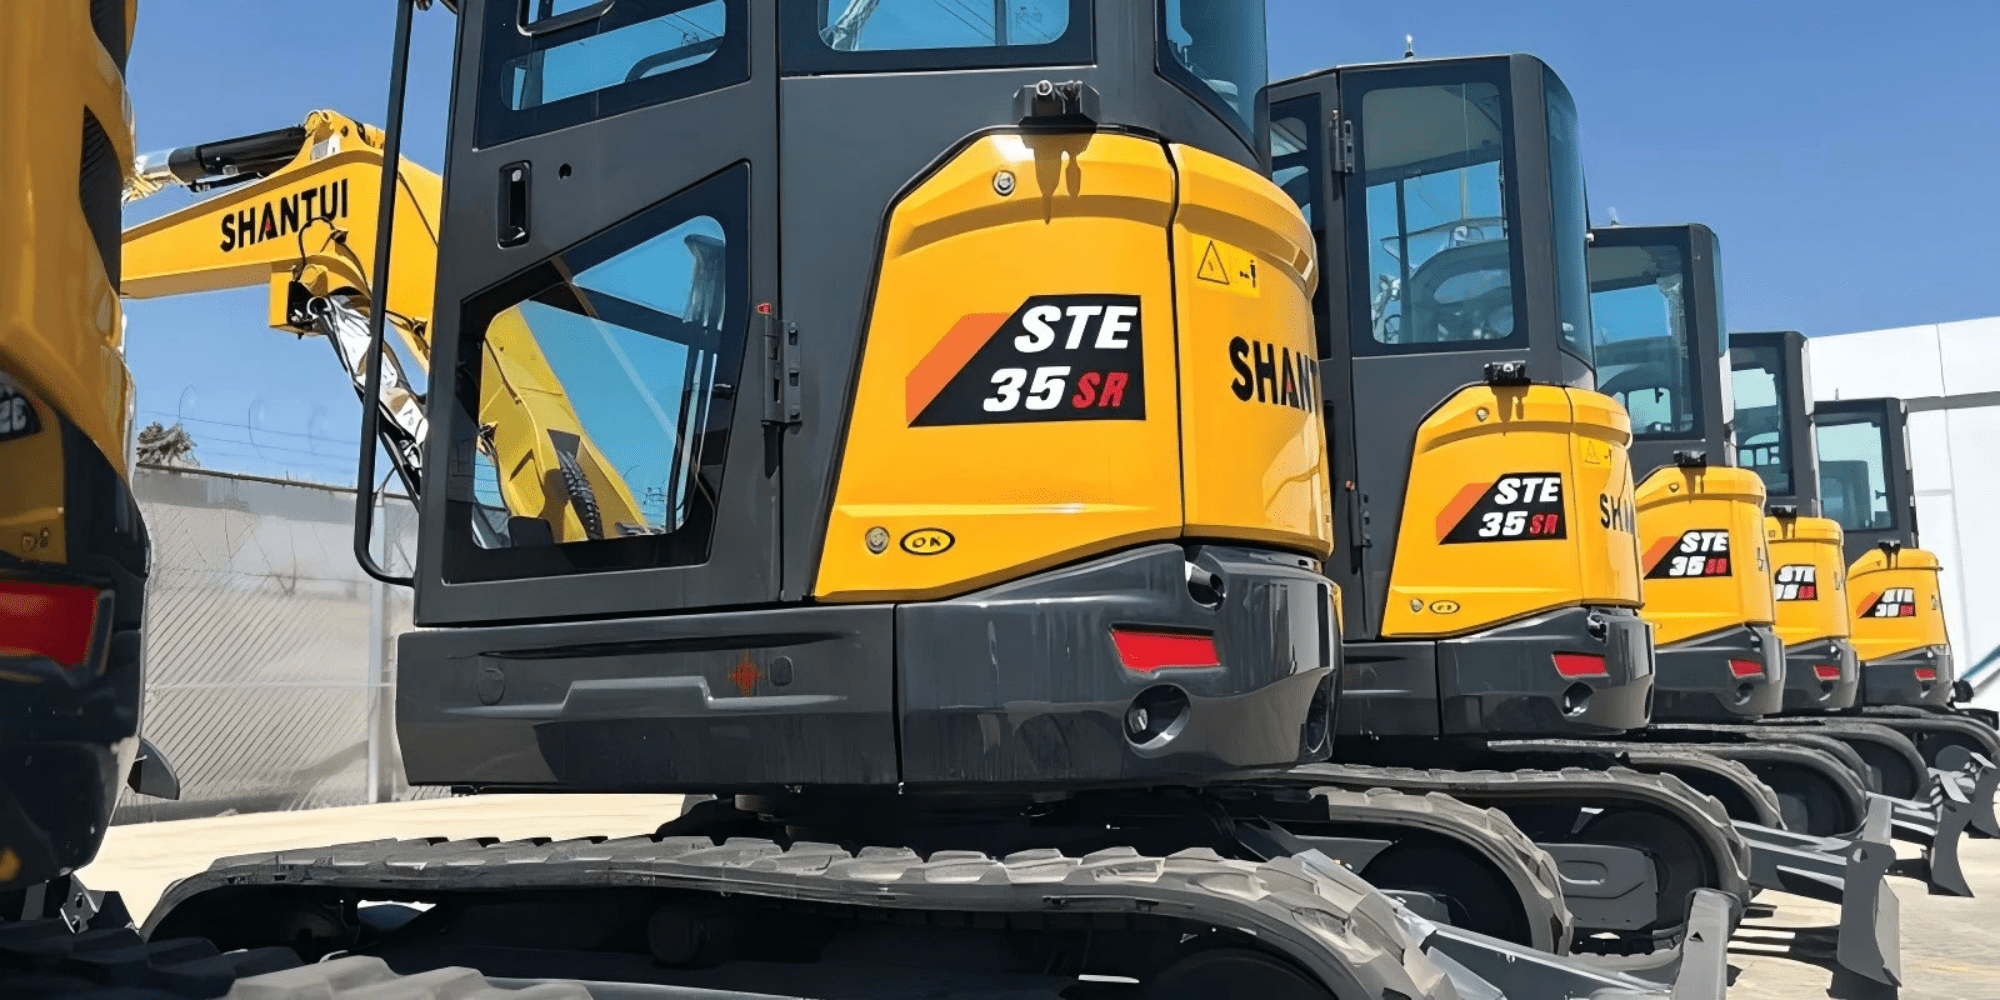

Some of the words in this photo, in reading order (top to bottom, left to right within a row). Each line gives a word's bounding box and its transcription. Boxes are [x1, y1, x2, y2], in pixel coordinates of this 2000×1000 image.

[220, 178, 348, 252] SHANTUI
[1014, 304, 1139, 353] STE
[1494, 477, 1561, 505] STE
[1680, 531, 1729, 553] STE
